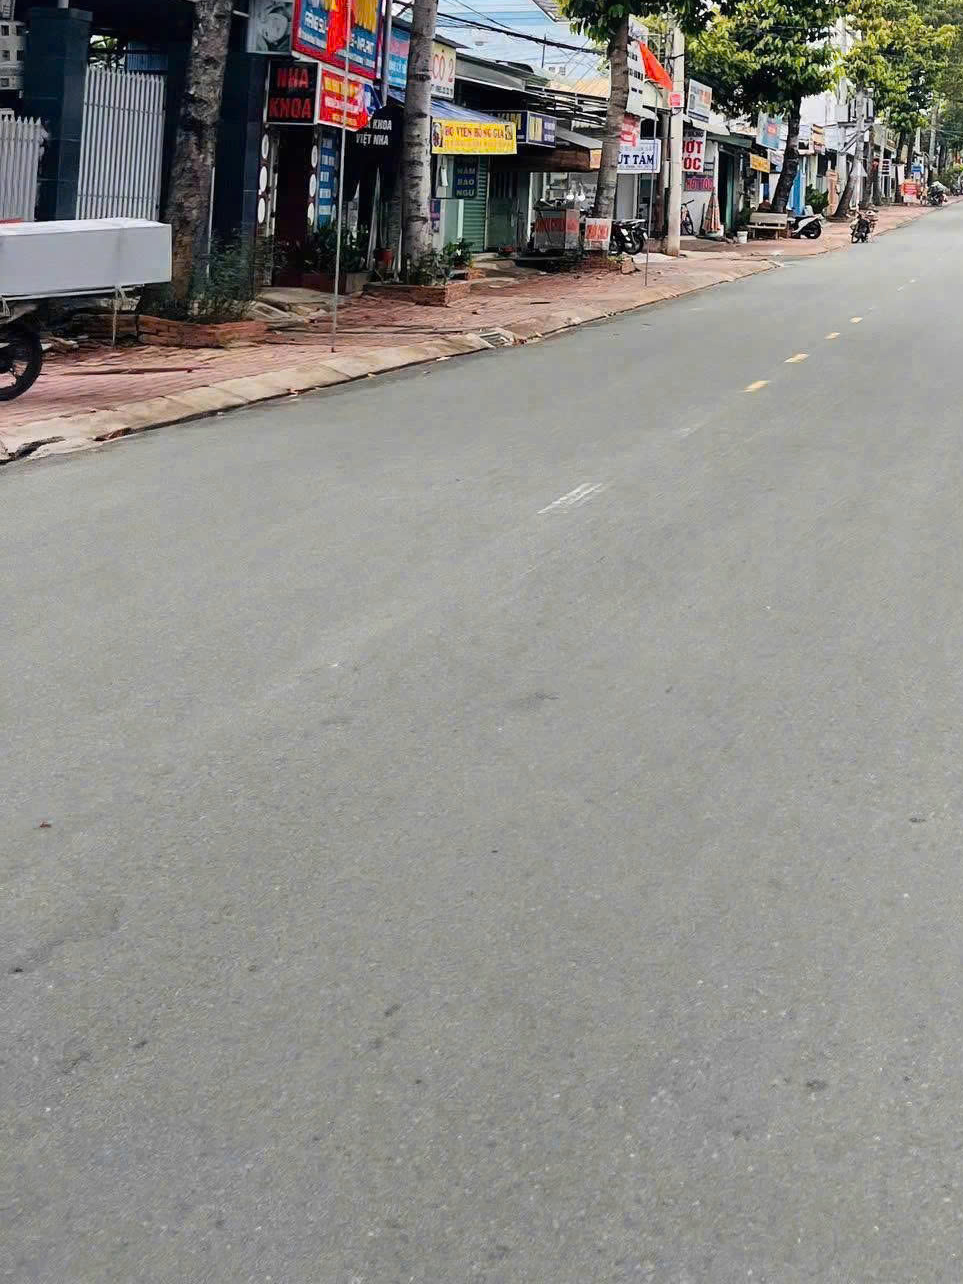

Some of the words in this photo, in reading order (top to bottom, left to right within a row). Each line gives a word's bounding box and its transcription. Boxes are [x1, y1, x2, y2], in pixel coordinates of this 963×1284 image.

[277, 67, 309, 88] NHA
[269, 97, 312, 119] KHOA
[372, 119, 392, 131] KHOA
[356, 132, 372, 147] VIỆT
[373, 134, 389, 146] NHA
[633, 152, 654, 165] TÁM
[682, 154, 701, 170] ÓC
